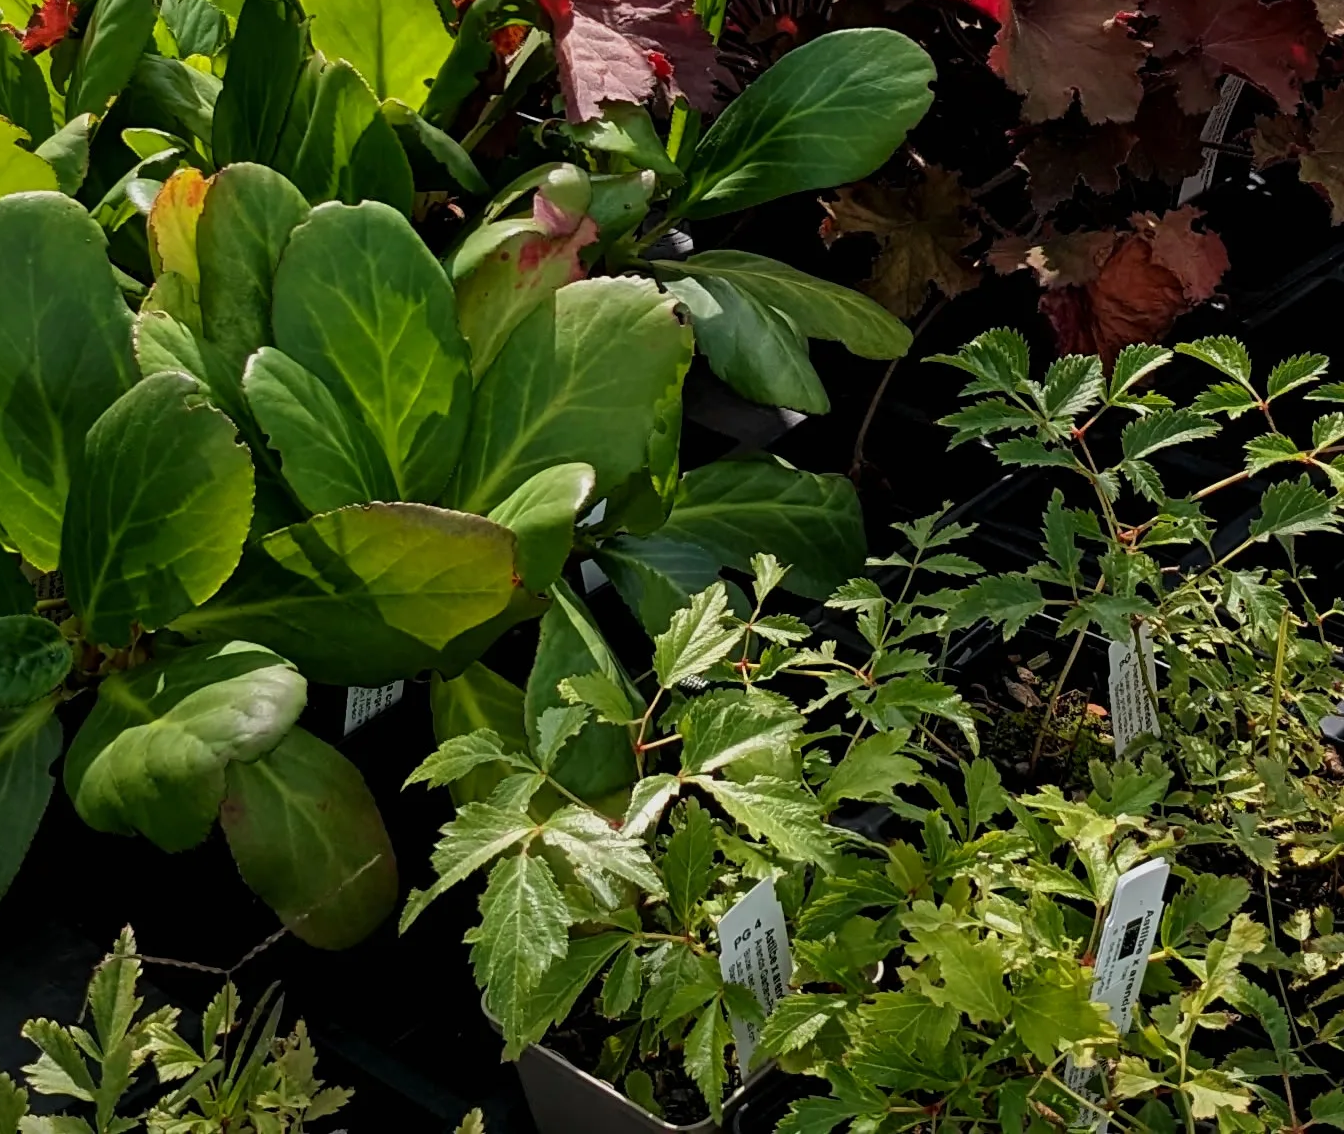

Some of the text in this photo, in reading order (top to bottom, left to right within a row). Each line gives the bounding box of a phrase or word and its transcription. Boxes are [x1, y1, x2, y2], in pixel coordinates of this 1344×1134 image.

[733, 918, 762, 952] PG 4
[764, 927, 779, 965] Astilbe
[1135, 909, 1155, 955] Astilbe
